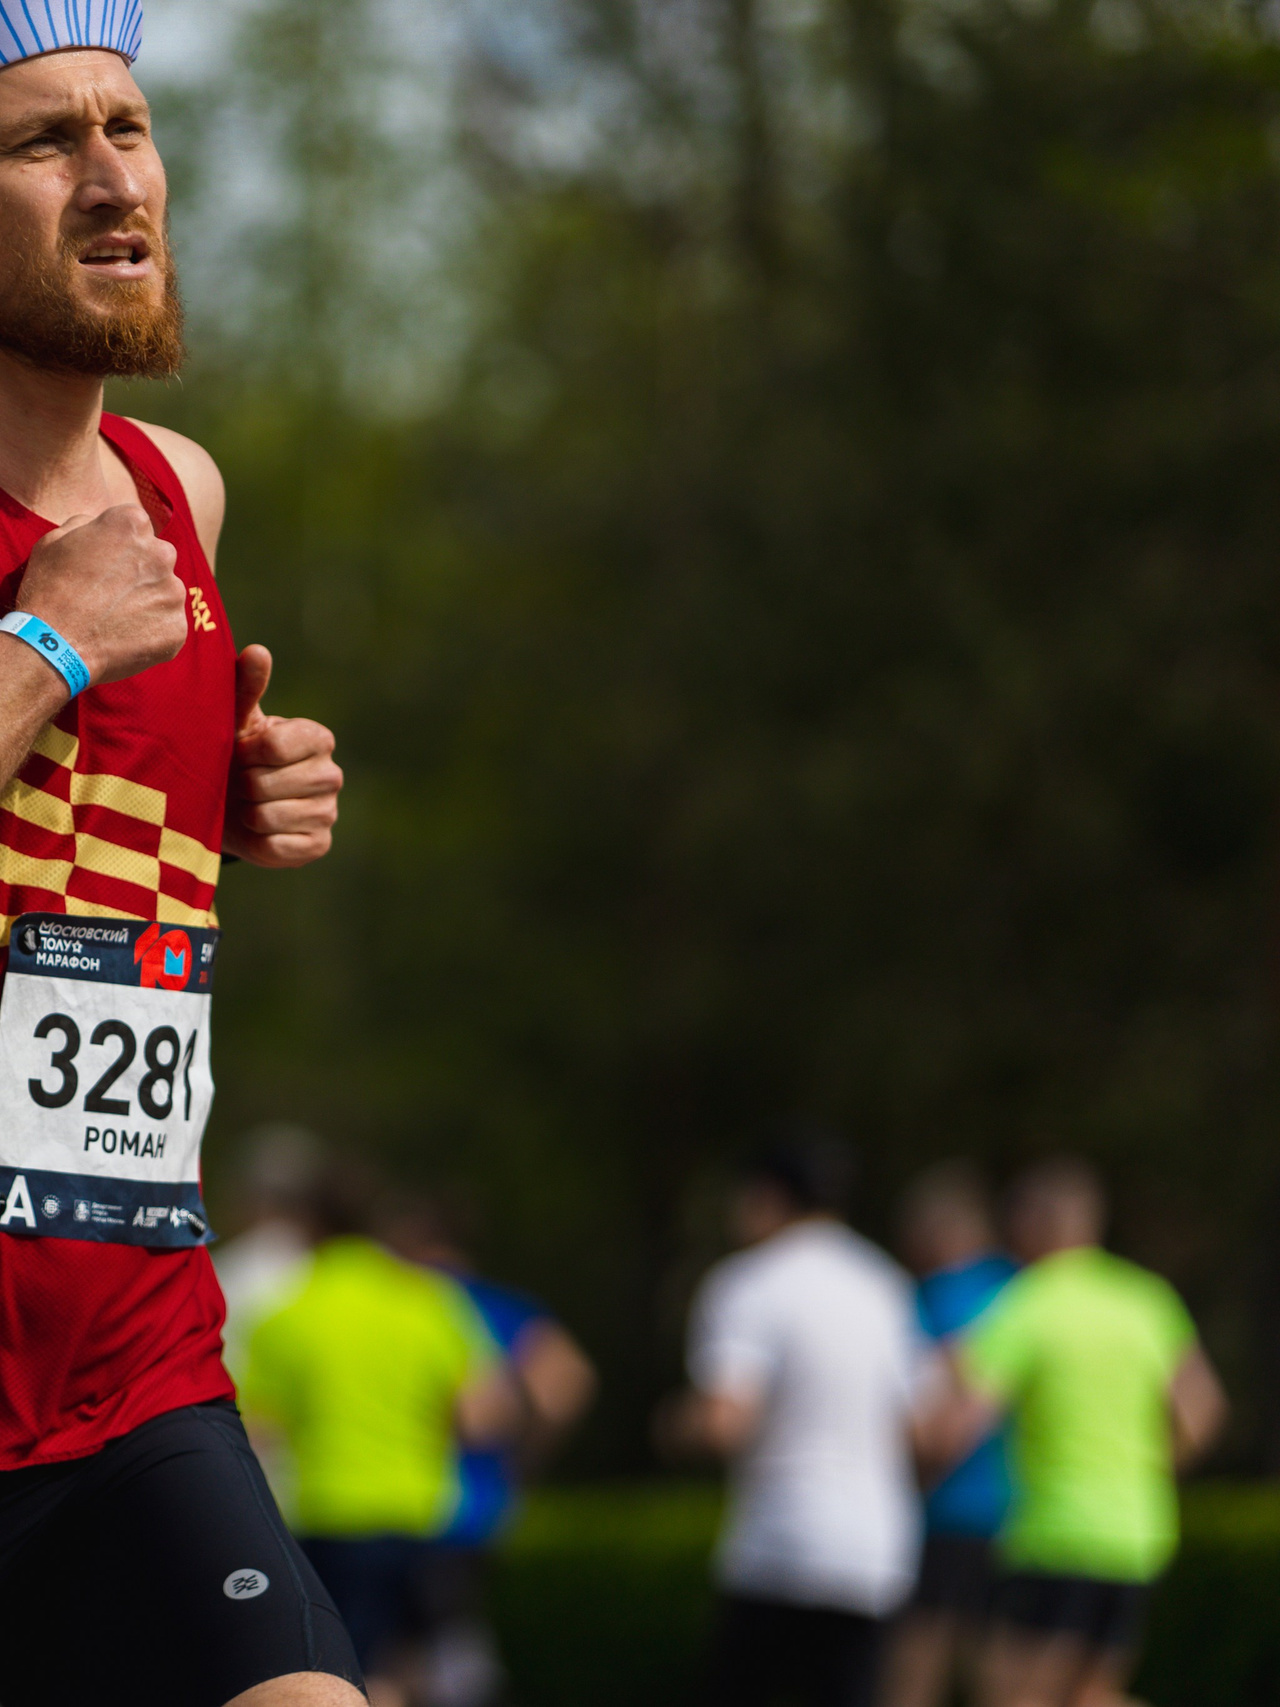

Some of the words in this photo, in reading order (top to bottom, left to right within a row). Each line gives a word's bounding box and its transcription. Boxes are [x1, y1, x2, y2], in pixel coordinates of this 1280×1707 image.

[38, 920, 130, 944] МОСКОВСКИЙ
[36, 952, 101, 971] МАРАФОН
[28, 1012, 197, 1121] 3281
[83, 1126, 167, 1159] РОМАН
